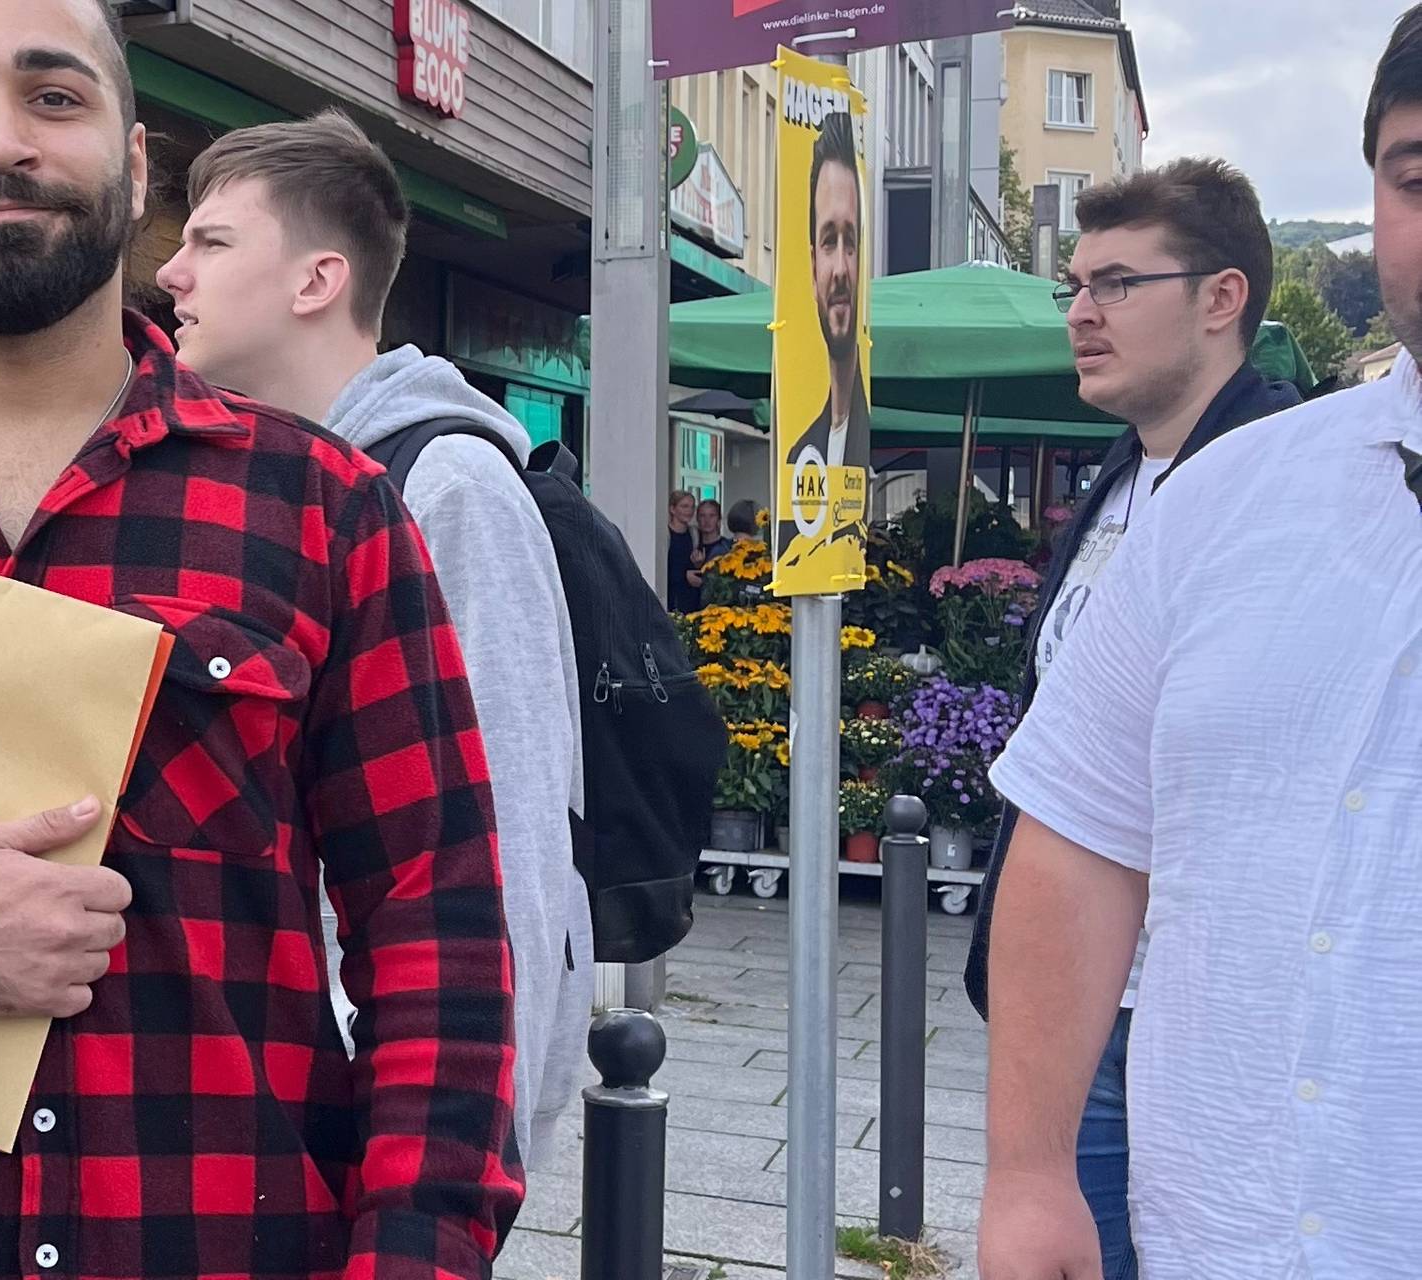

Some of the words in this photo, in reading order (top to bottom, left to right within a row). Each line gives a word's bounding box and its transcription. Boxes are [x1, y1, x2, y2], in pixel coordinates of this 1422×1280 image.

[410, 0, 467, 64] BLUME
[762, 3, 885, 31] www.dielinke-hagen.de
[415, 44, 464, 112] 2000
[796, 475, 826, 498] HAK
